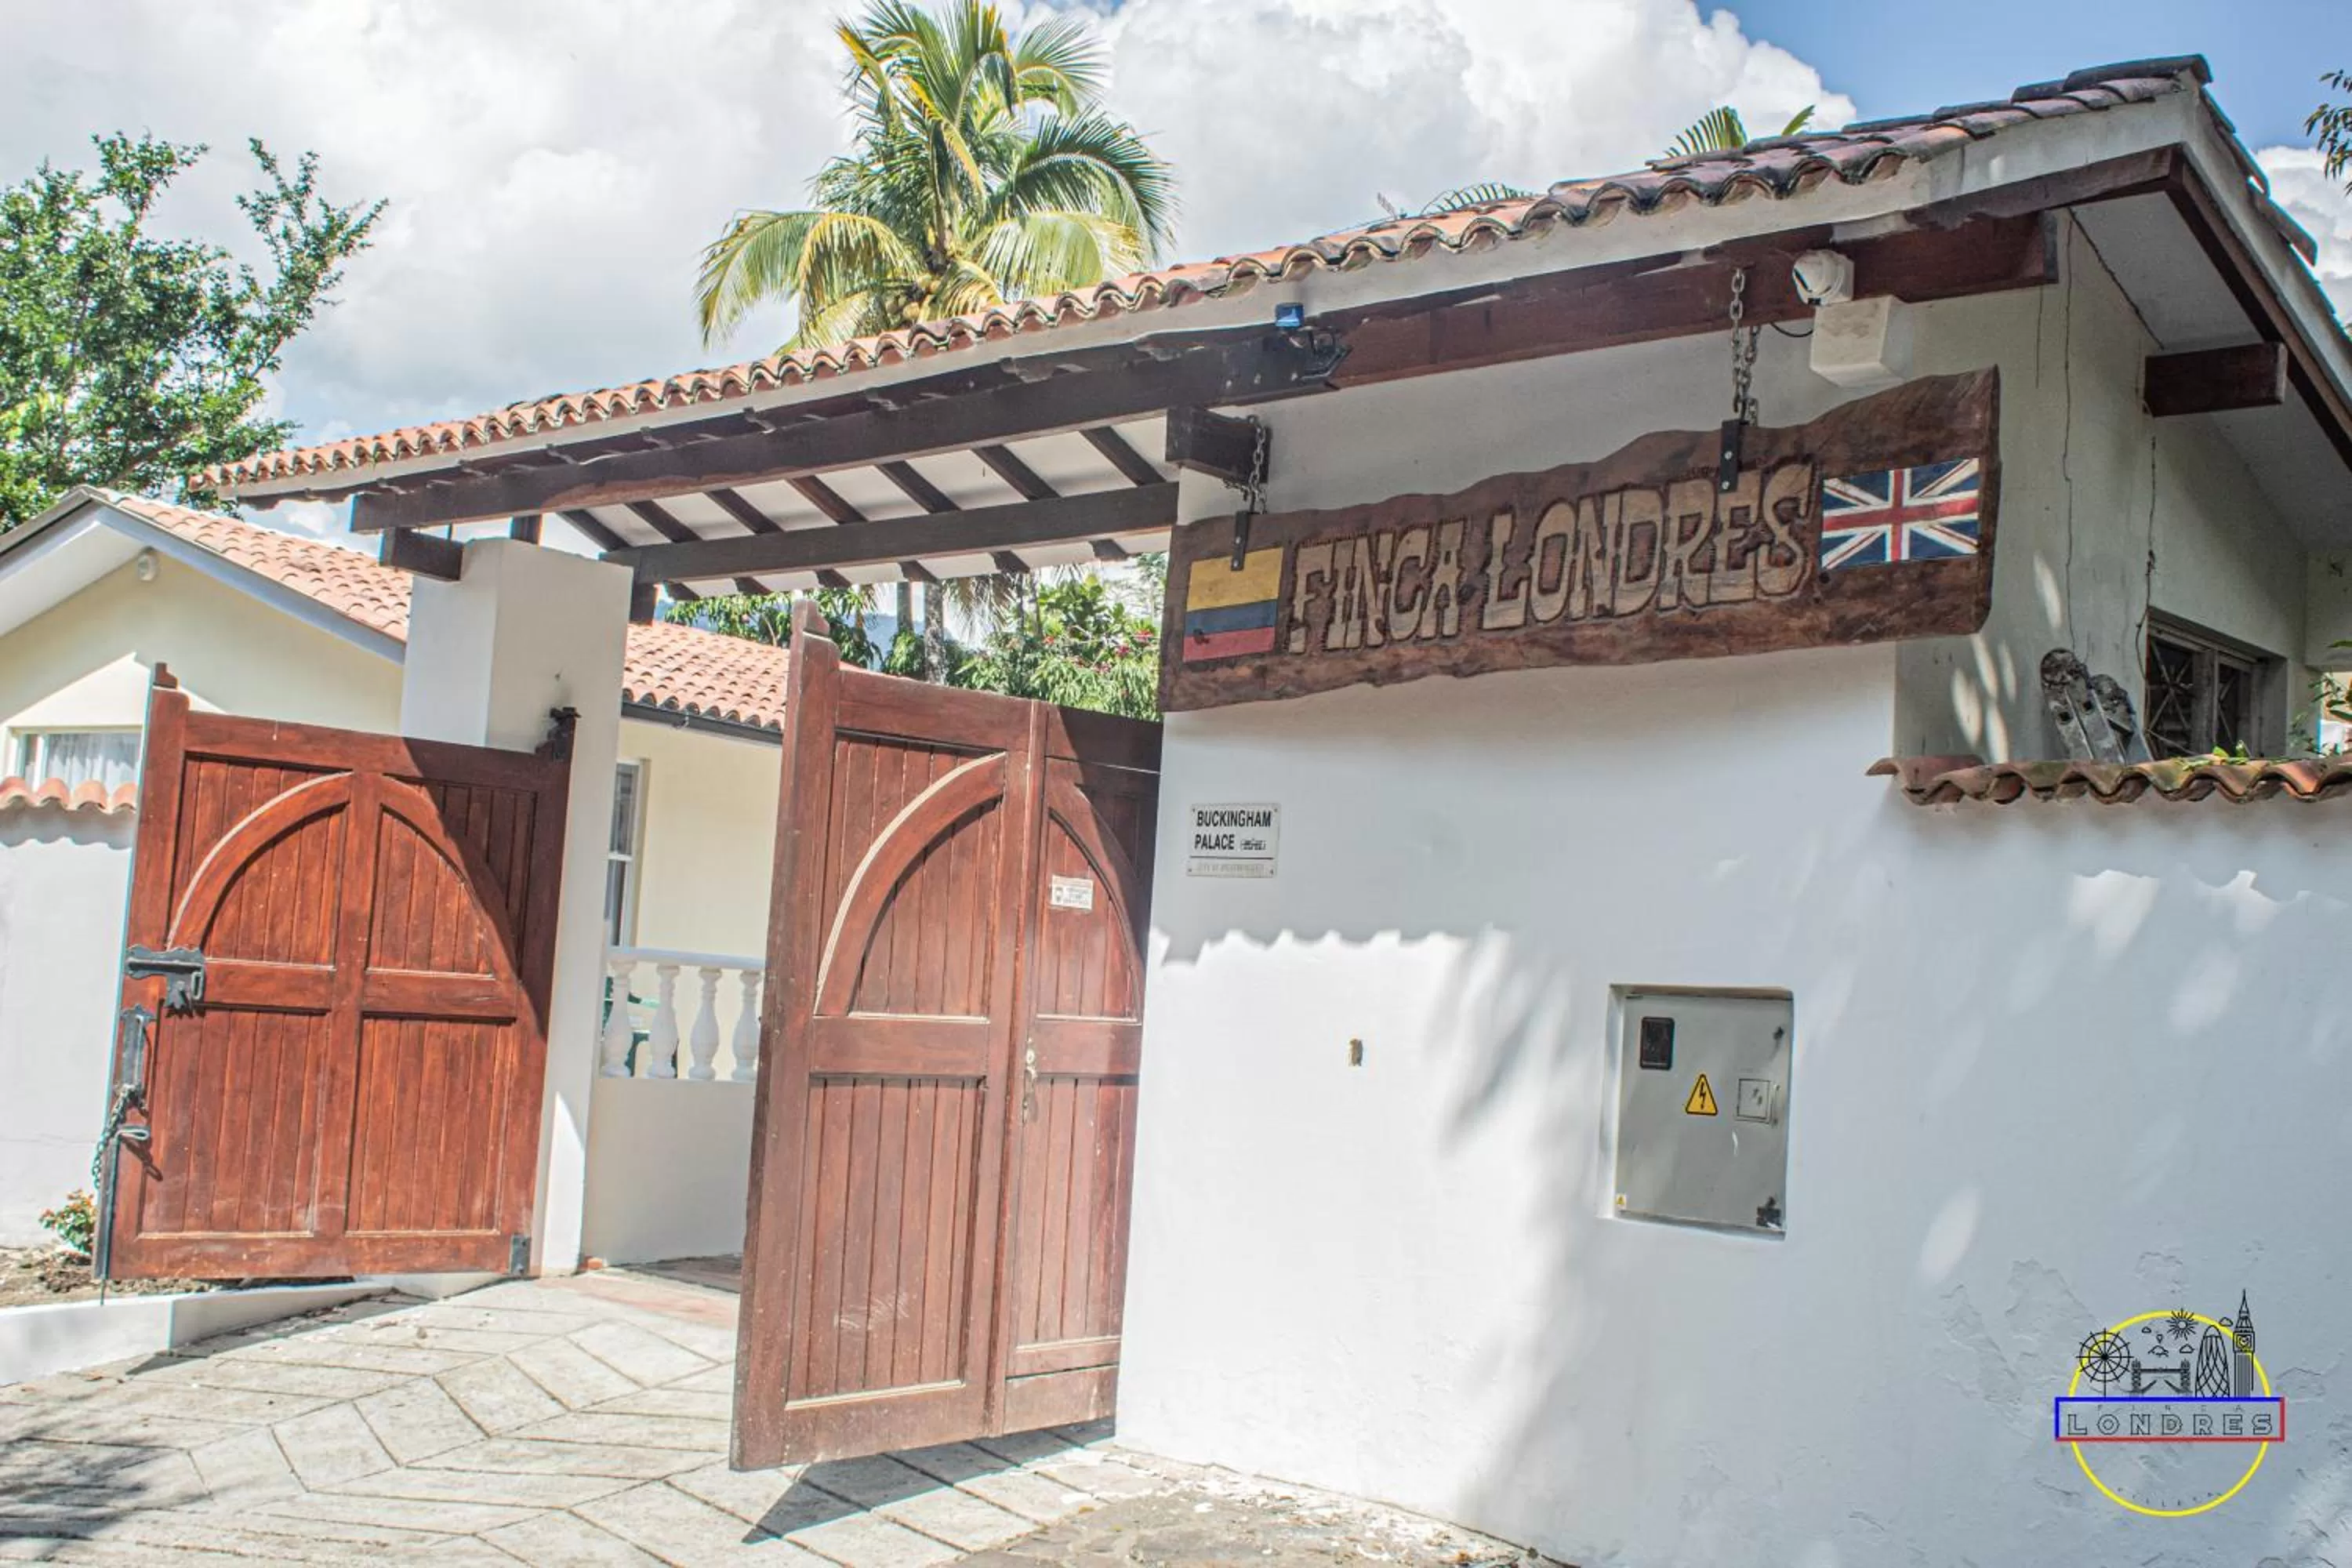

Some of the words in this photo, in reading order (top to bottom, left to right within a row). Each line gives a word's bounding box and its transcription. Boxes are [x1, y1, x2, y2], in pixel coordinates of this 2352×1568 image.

[1288, 519, 1465, 654] FINCA
[1483, 463, 1813, 630] LONDRES
[1196, 810, 1272, 827] BUCKINGHAM
[1194, 833, 1235, 851] PALACE
